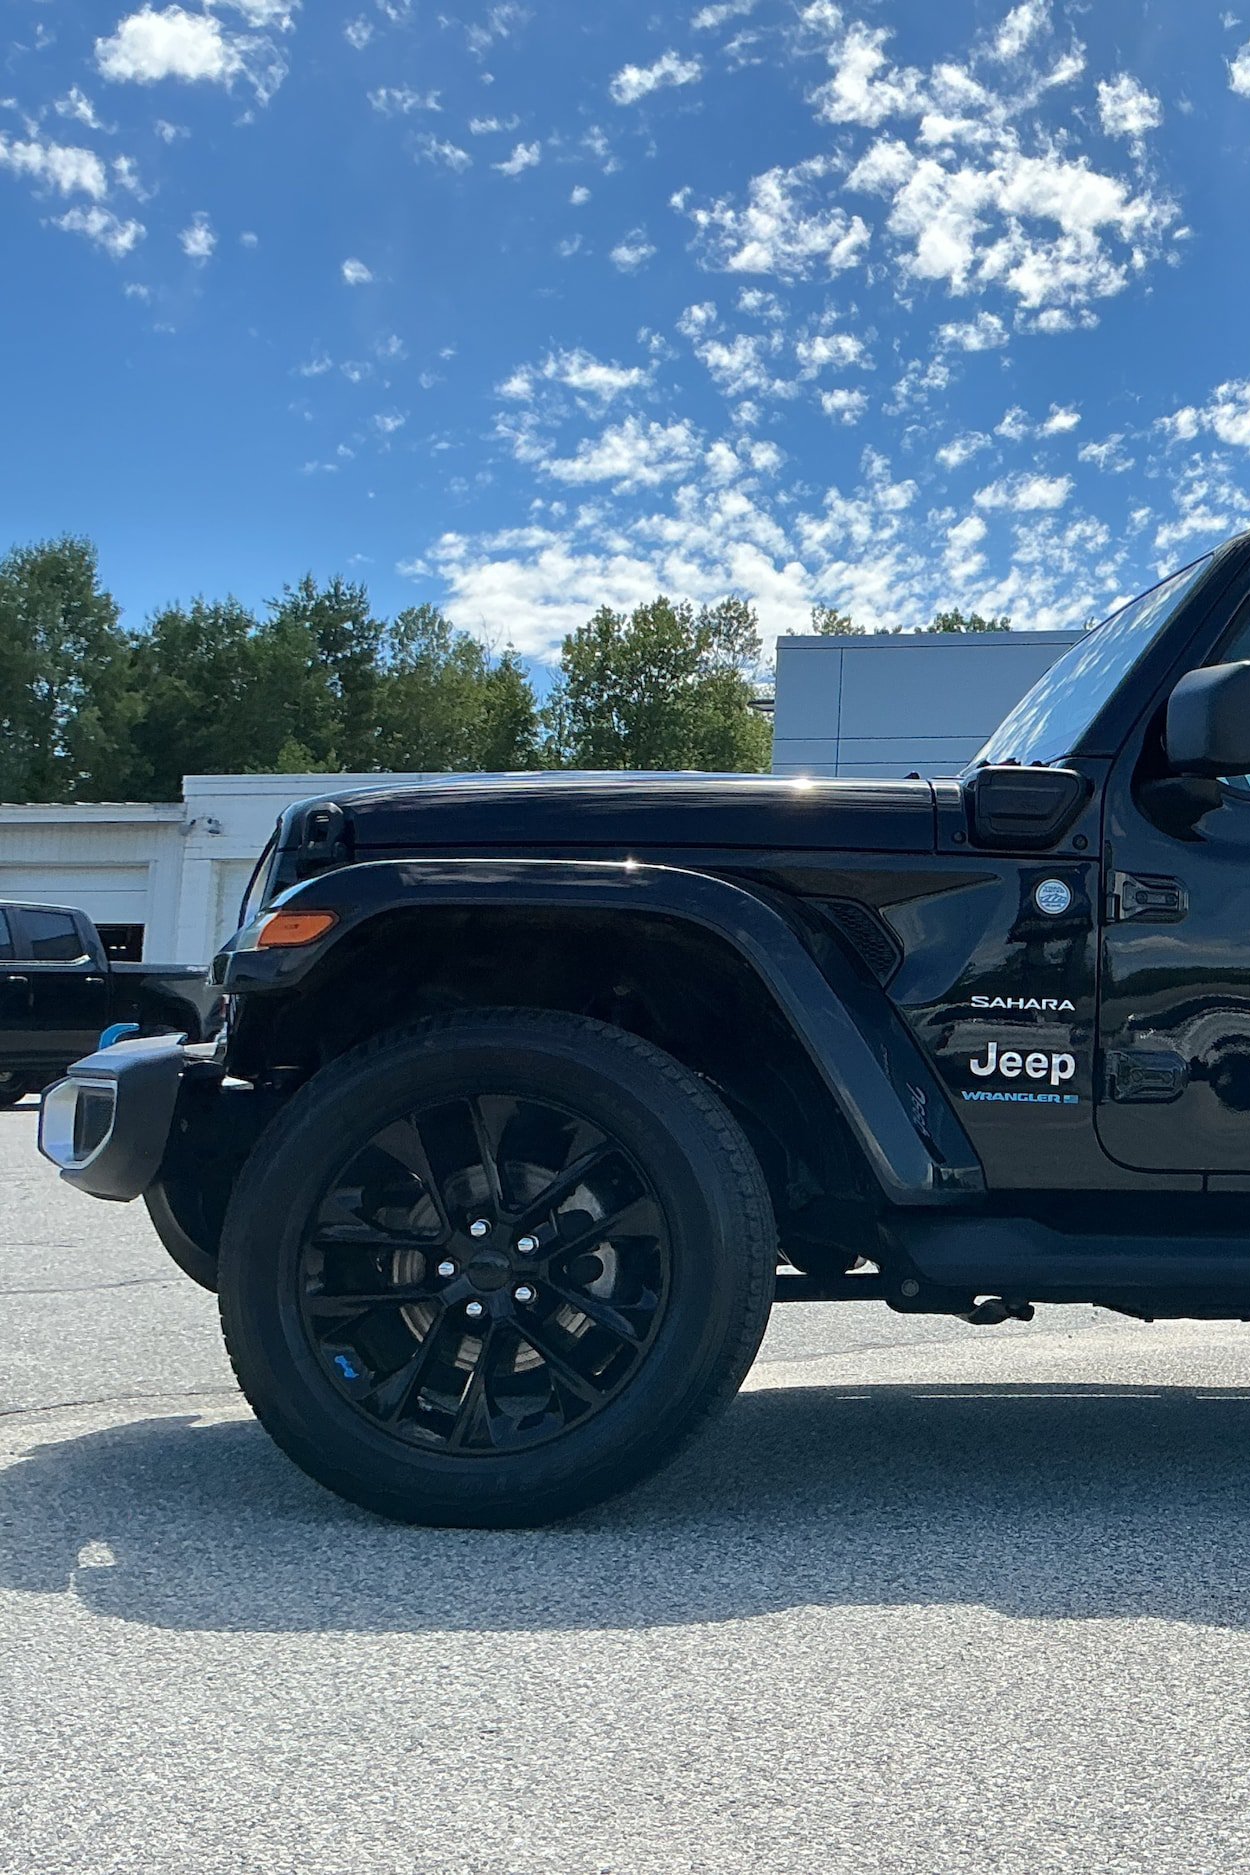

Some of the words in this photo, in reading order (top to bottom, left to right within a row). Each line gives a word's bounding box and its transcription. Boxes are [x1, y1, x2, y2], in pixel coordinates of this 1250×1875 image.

[970, 995, 1076, 1012] SAHARA
[969, 1041, 1076, 1086] Jeep
[961, 1090, 1061, 1104] WRANGLER
